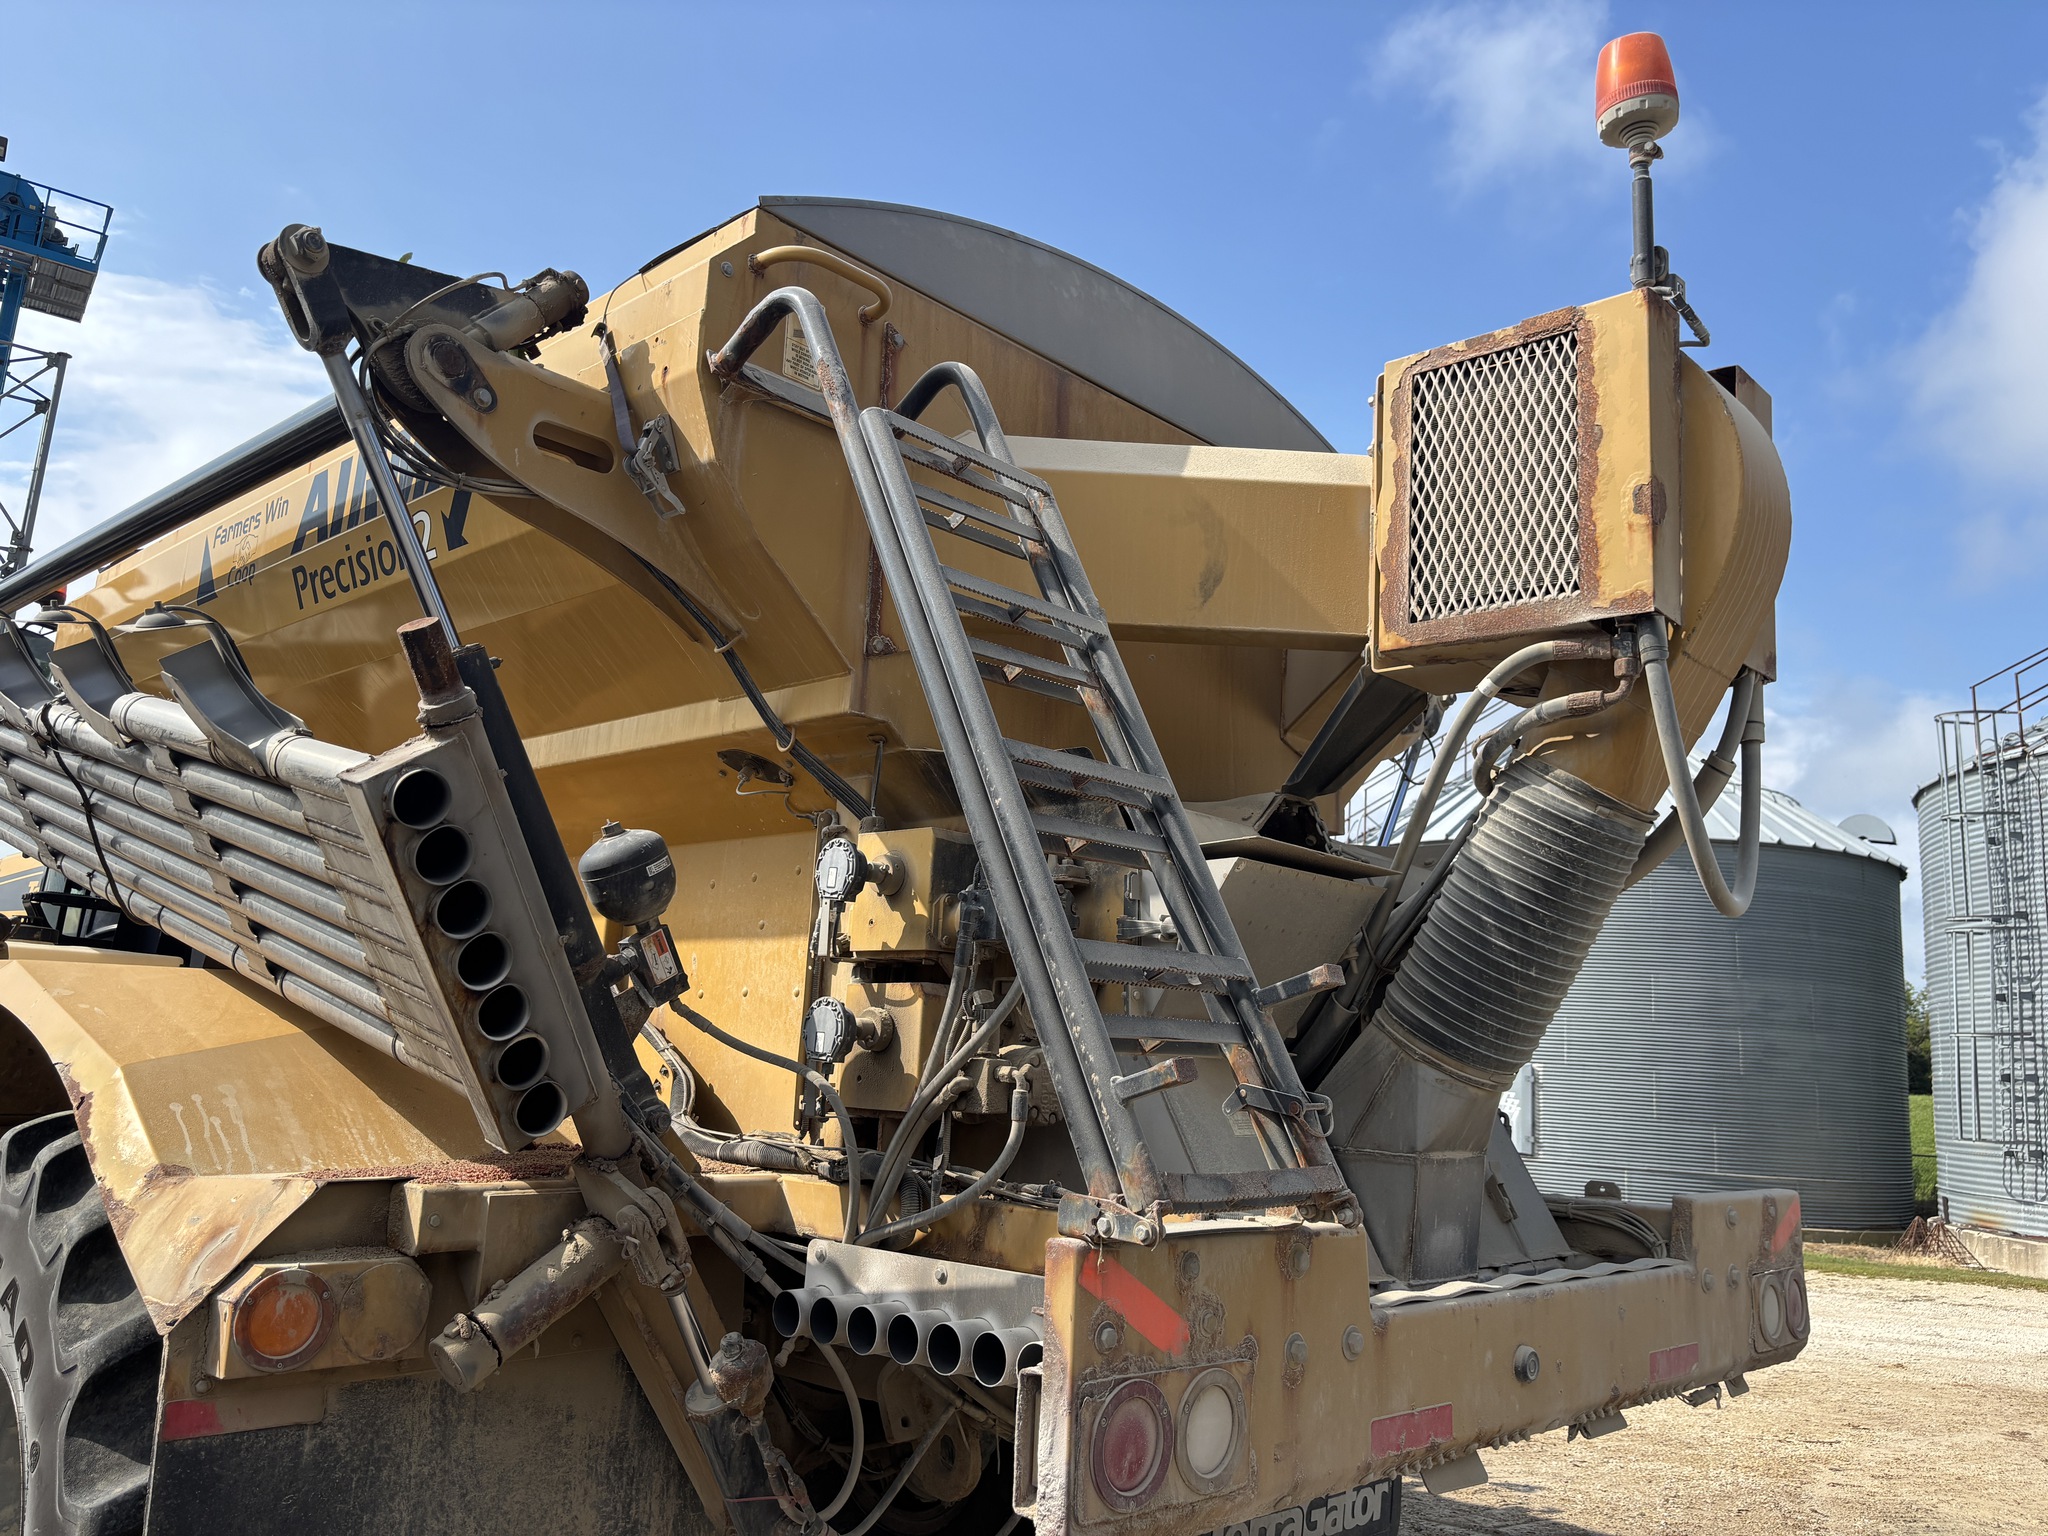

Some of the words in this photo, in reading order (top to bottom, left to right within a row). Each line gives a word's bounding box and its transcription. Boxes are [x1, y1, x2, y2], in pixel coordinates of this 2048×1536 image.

[212, 511, 262, 549] Farmers
[265, 496, 289, 525] Win
[411, 510, 438, 562] 2
[227, 563, 256, 587] Coop
